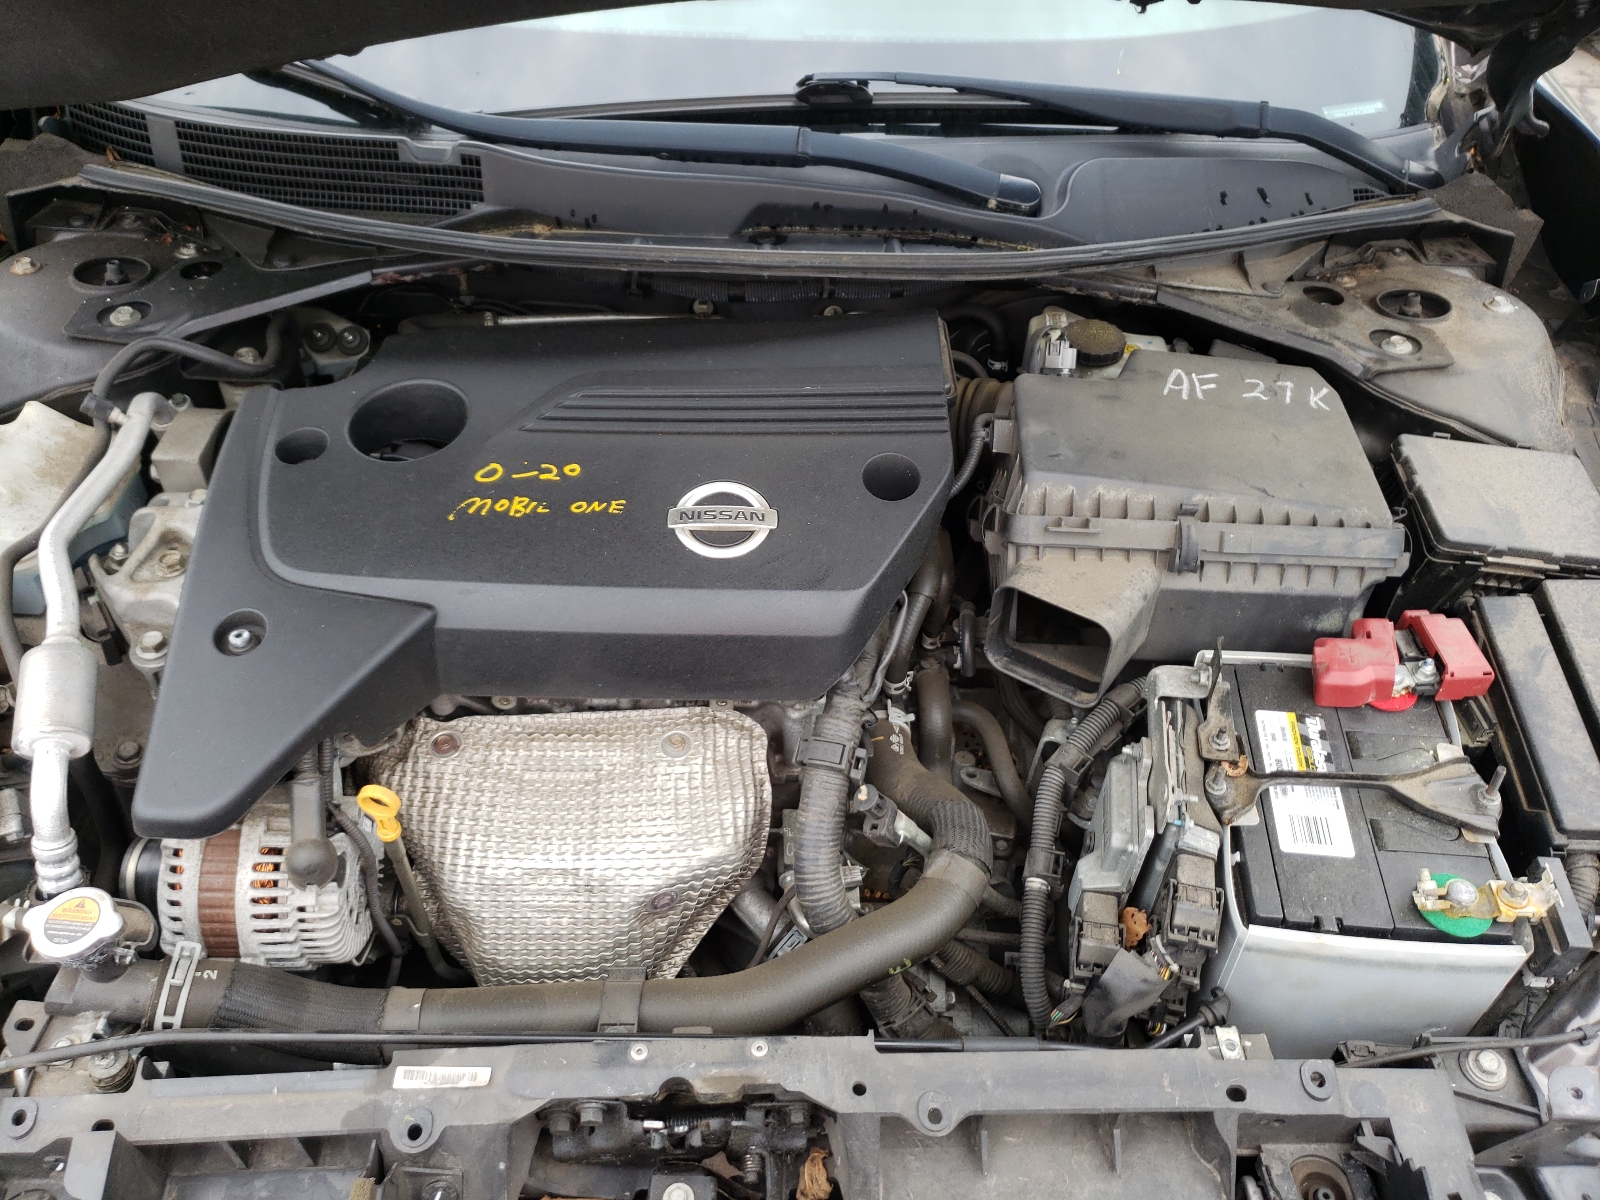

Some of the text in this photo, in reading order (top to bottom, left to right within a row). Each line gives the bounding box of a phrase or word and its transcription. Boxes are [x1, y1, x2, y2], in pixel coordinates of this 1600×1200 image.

[1163, 368, 1219, 400] AF
[570, 499, 626, 514] ONE
[680, 510, 765, 521] NISSAN
[61, 907, 93, 915] WARNING
